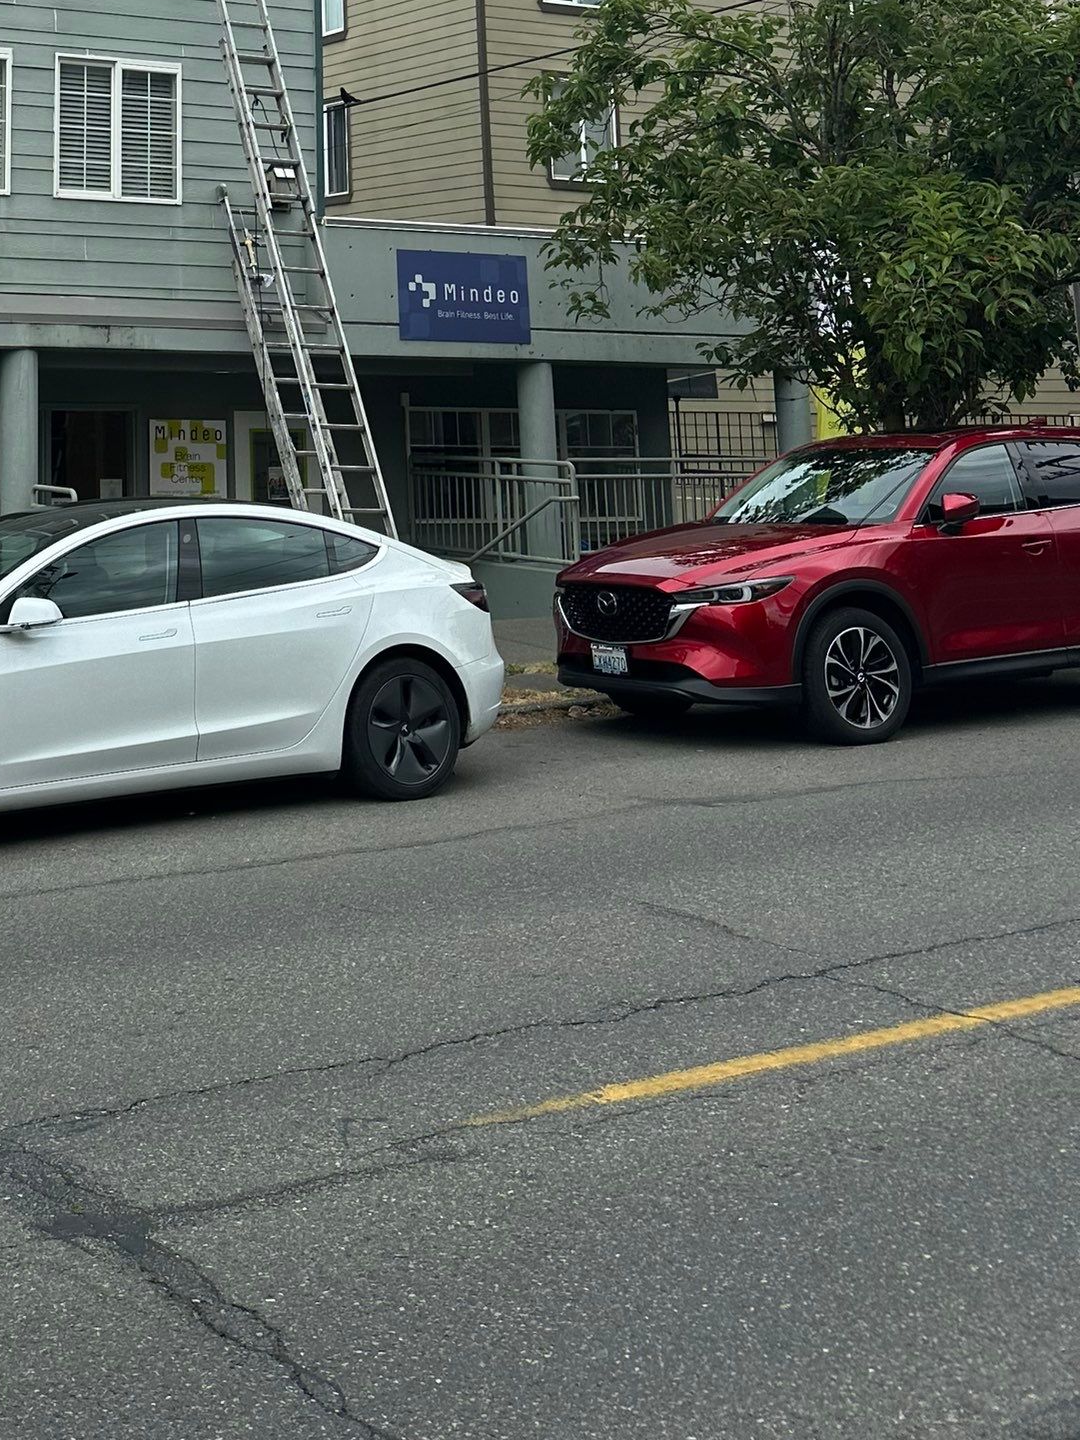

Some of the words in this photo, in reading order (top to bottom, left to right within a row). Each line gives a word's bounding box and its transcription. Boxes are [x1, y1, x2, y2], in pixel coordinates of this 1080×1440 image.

[444, 283, 519, 304] Mindeo
[437, 309, 455, 318] Brain
[483, 311, 499, 320] Best
[155, 426, 222, 441] Mindeo
[175, 451, 200, 461] Brain
[170, 463, 207, 472] Fitness
[170, 474, 205, 484] Center
